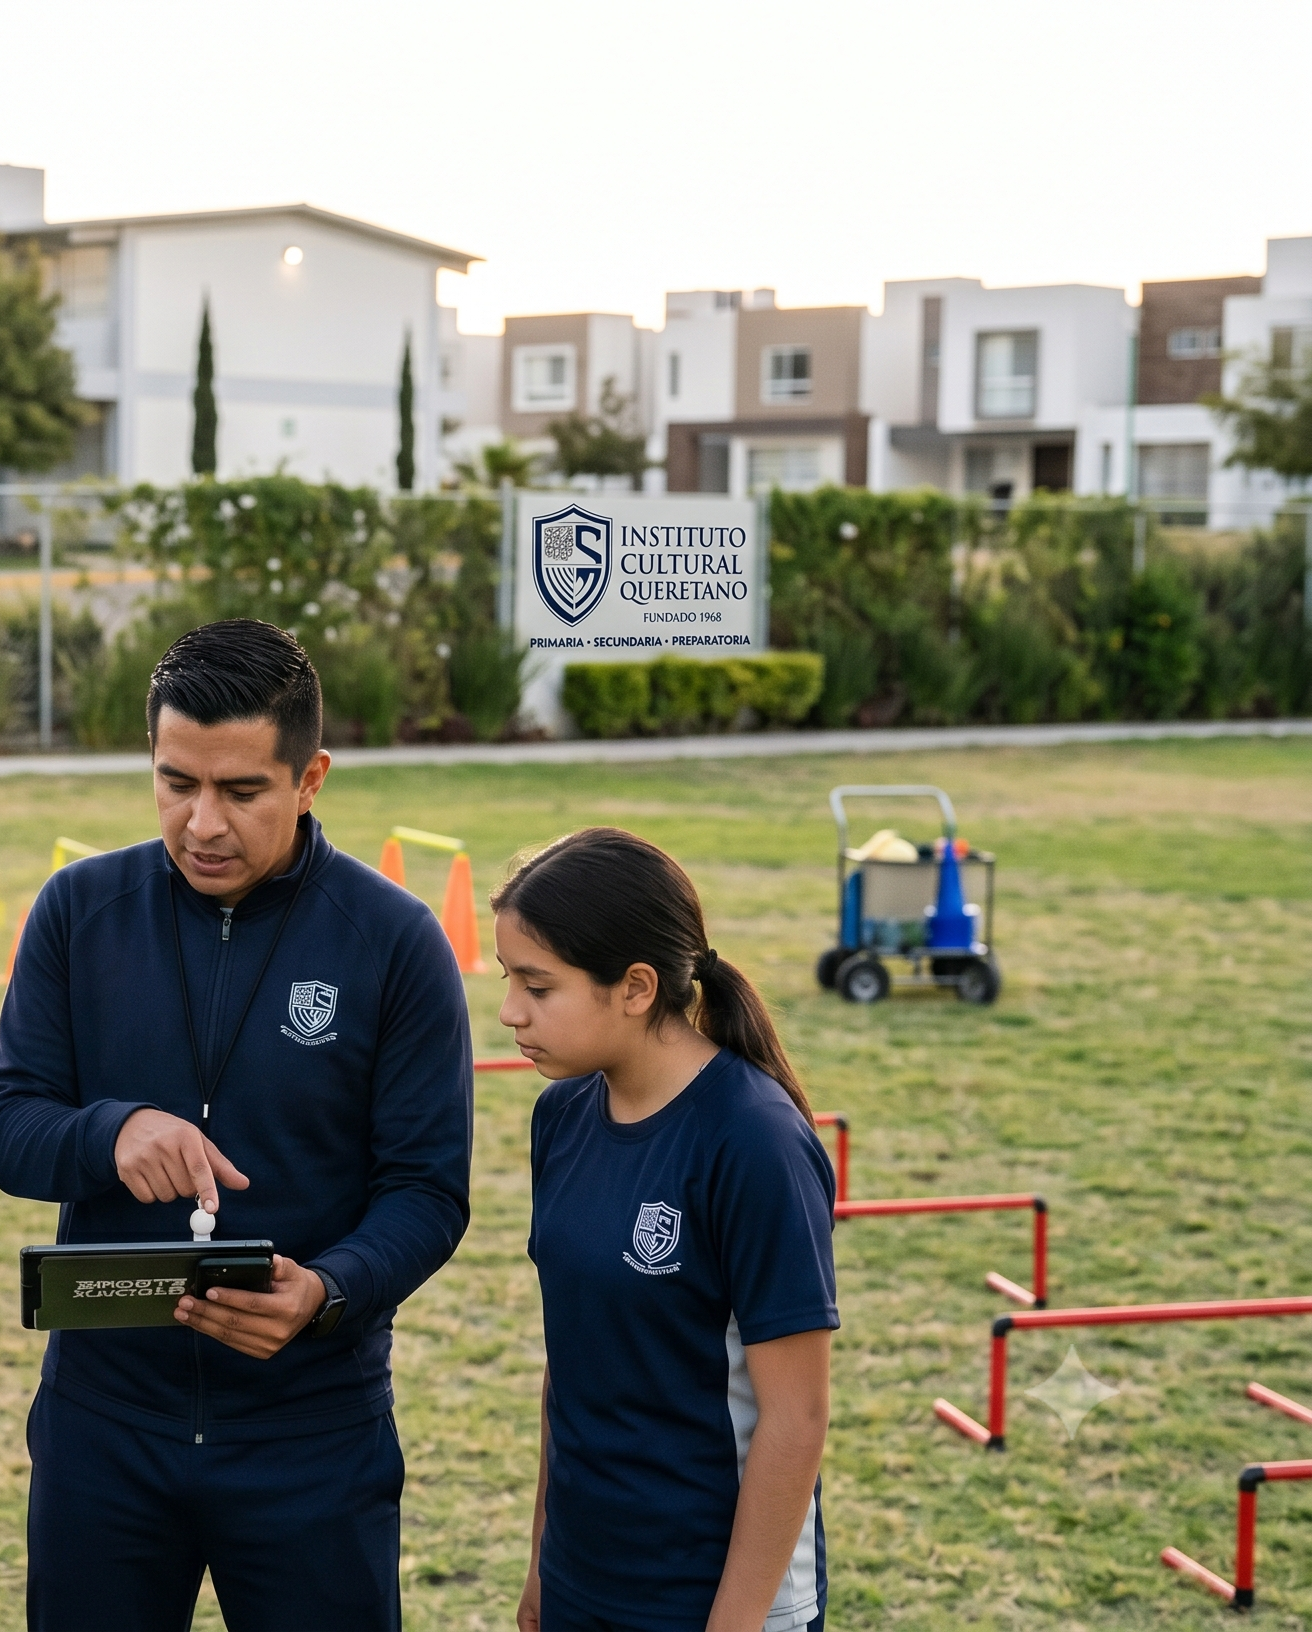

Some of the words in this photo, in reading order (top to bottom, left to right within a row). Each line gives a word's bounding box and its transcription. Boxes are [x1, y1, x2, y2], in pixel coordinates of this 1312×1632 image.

[621, 526, 746, 548] INSTITUTO
[620, 553, 743, 575] CULTURAL
[619, 580, 748, 605] QUERETANO
[643, 612, 697, 623] FUNDADO
[699, 611, 722, 623] 1968
[530, 637, 584, 649] PRIMARIA
[593, 636, 662, 648] SECUNDARIA
[671, 634, 751, 647] PREPARATORIA
